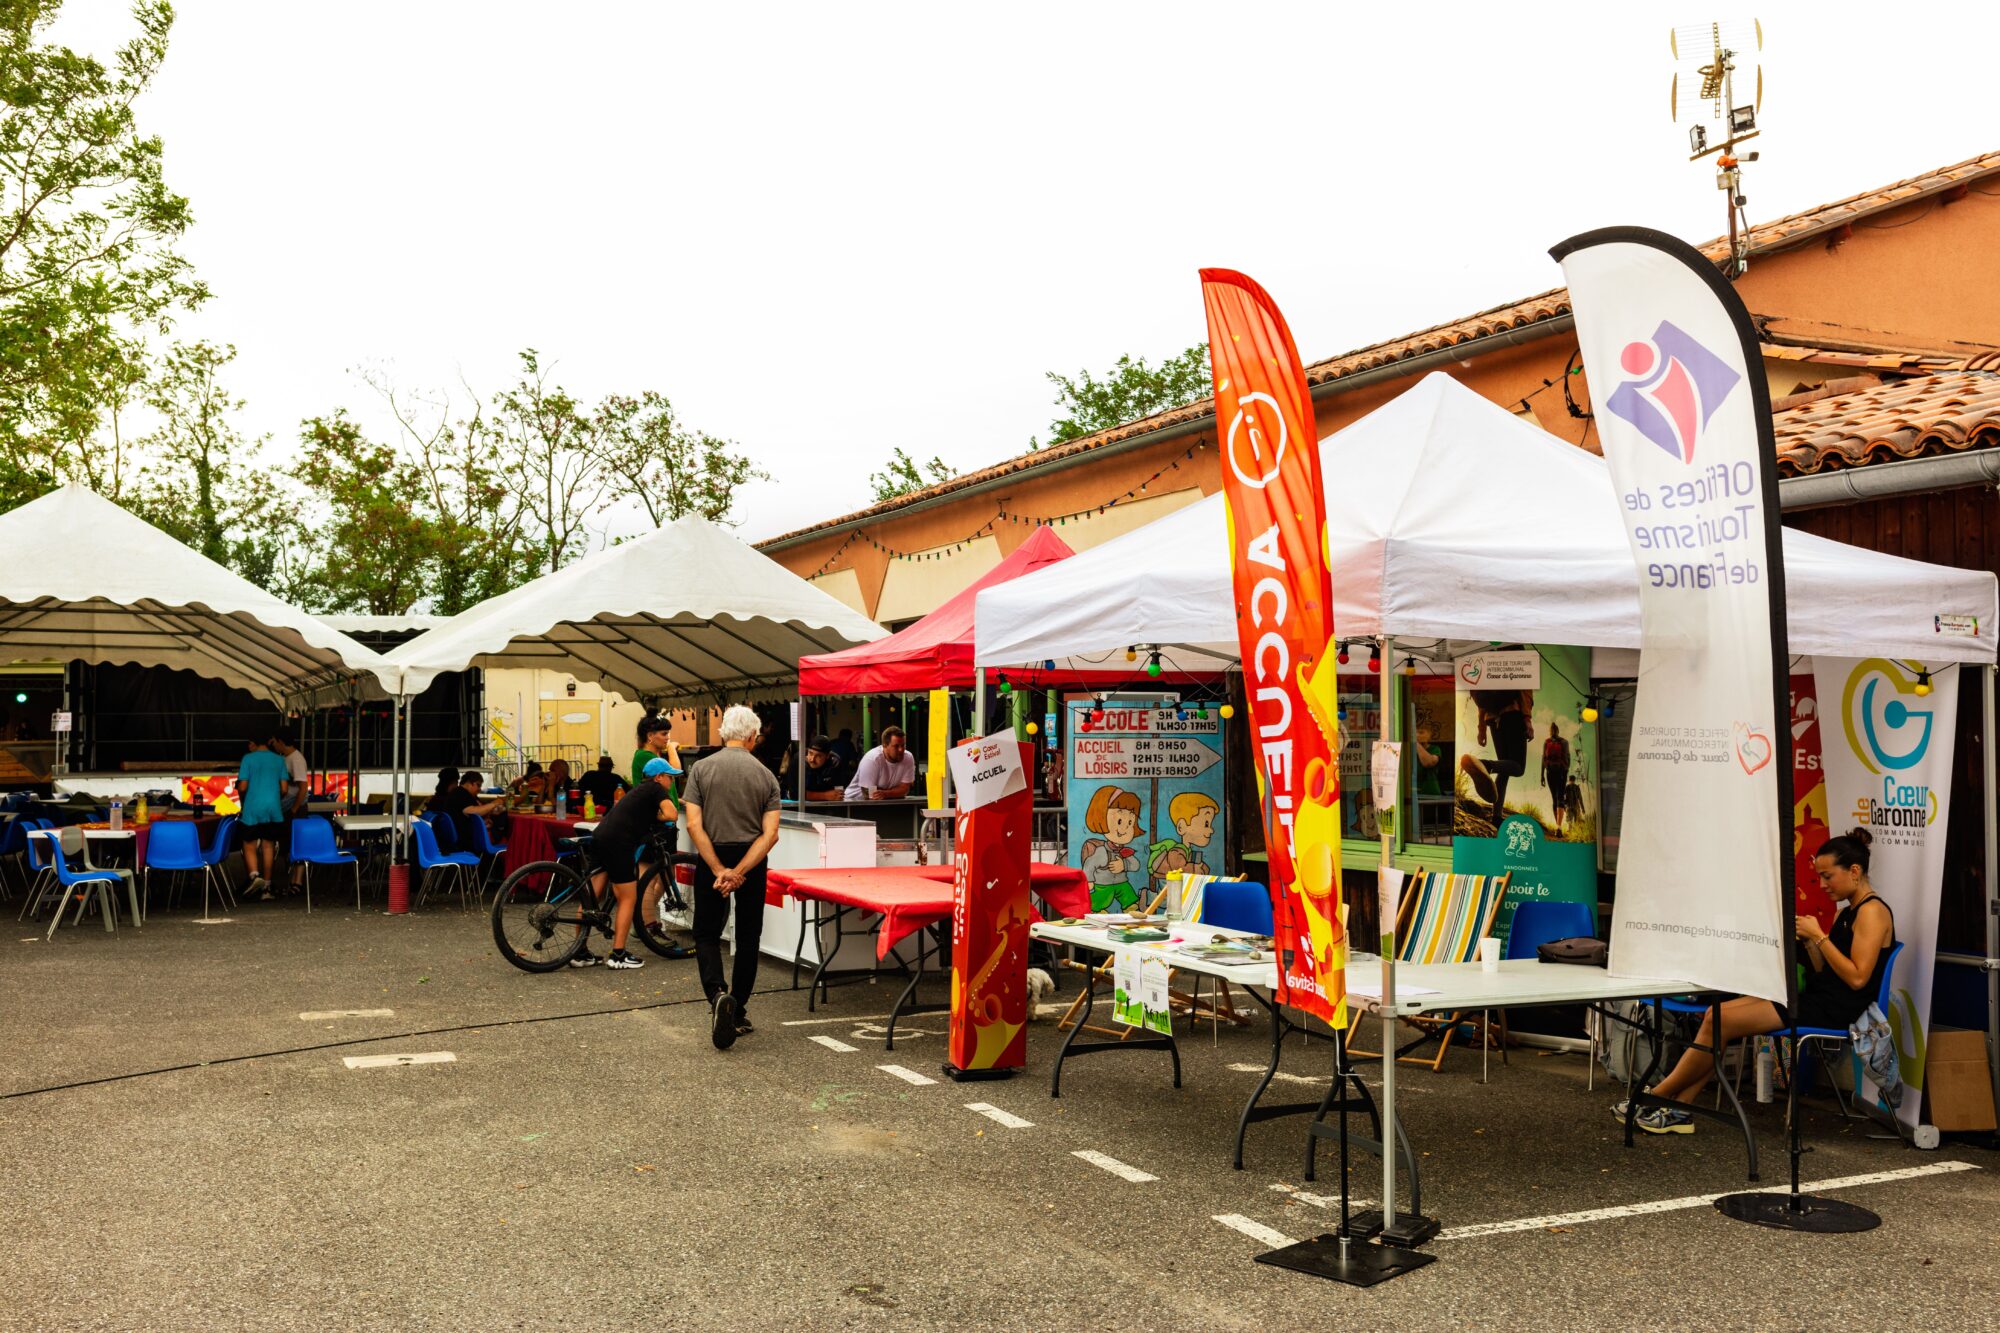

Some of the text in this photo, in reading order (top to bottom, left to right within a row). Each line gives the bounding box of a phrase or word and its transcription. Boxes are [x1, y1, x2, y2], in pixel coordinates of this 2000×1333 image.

[1077, 741, 1188, 753] ACCUEIL 8H 8H50
[1132, 754, 1164, 764] 12H15
[971, 764, 1007, 784] ACCUEIL
[1085, 762, 1198, 776] LOISIRS 17H15 18H30
[1852, 798, 1926, 828] de Garonne
[1537, 882, 1551, 896] le
